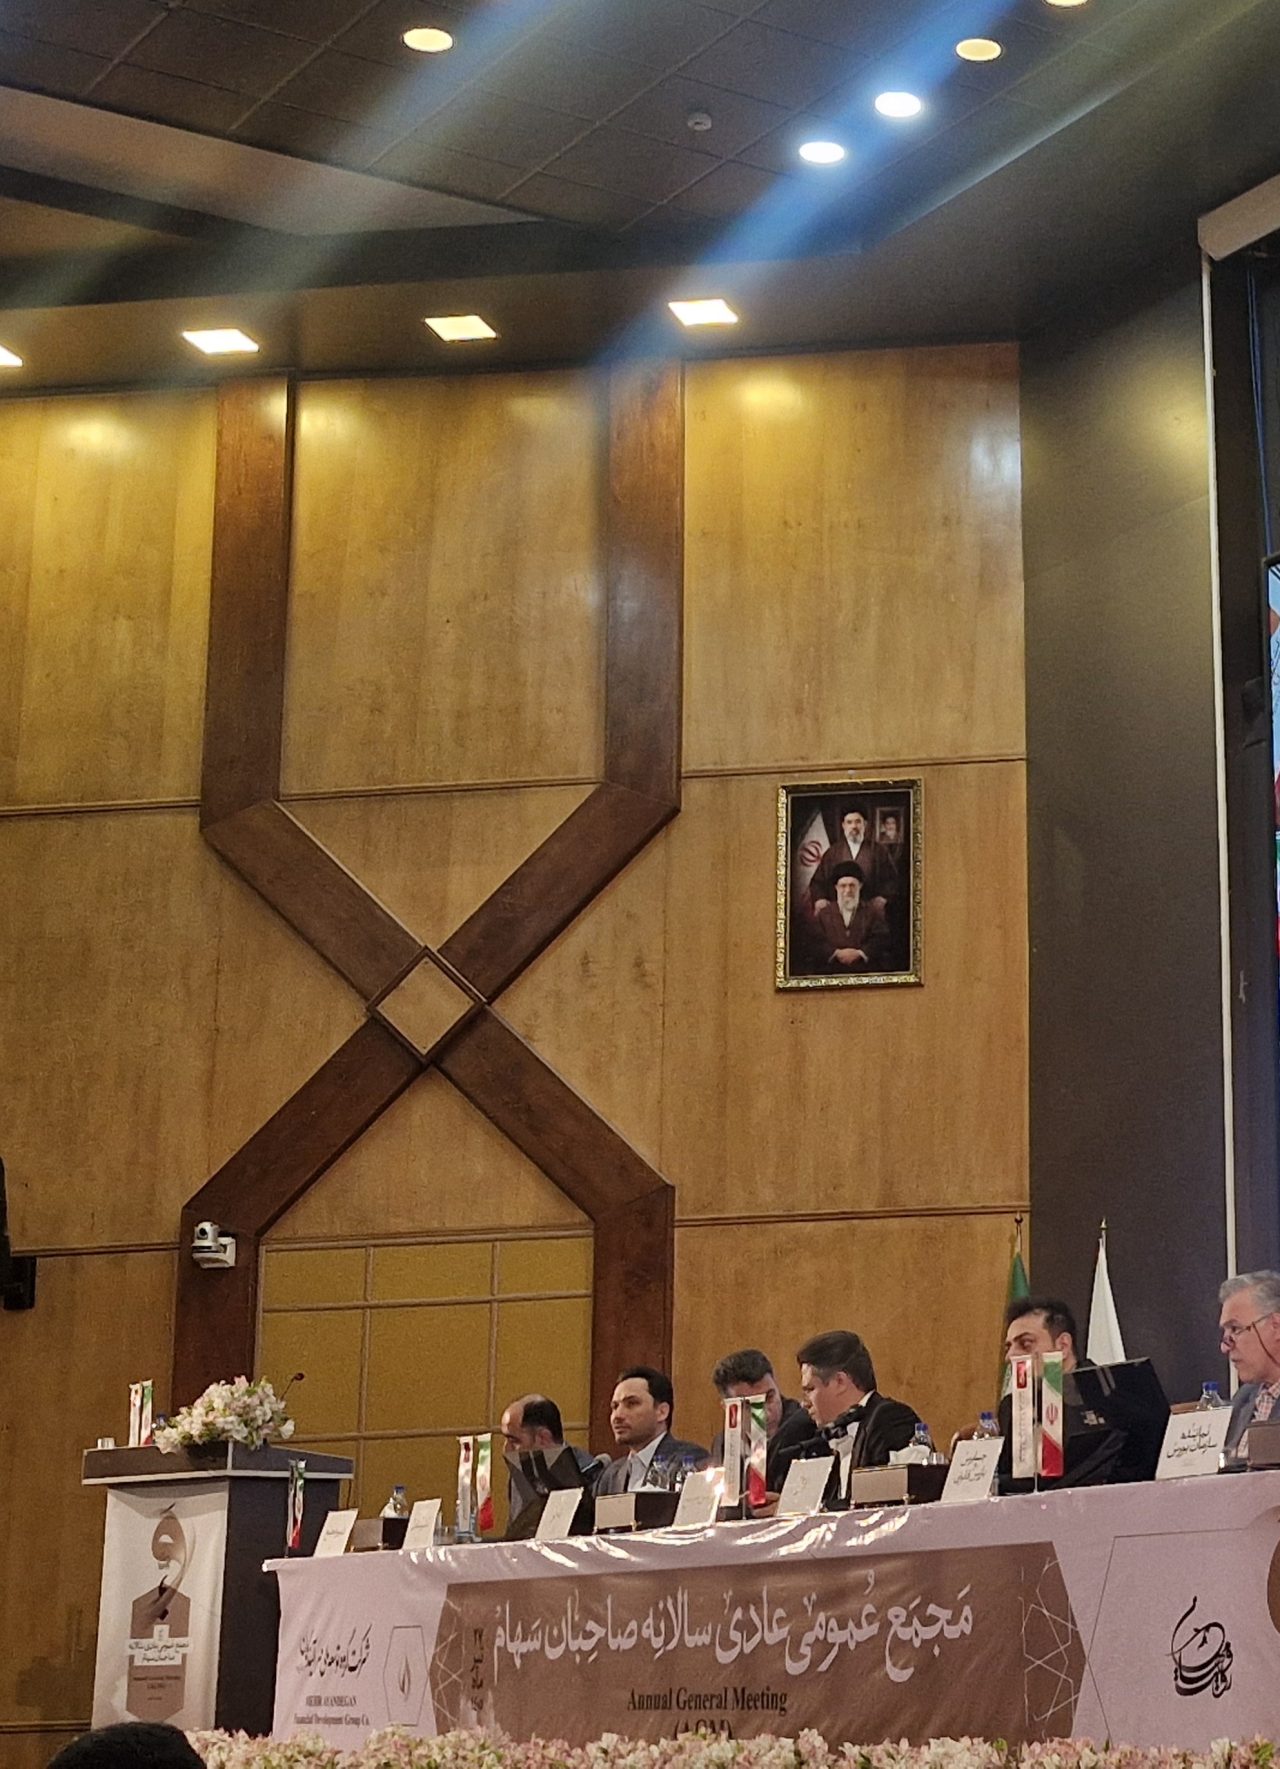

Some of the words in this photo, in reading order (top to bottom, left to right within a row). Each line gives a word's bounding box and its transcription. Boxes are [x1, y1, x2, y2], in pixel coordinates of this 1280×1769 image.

[627, 1686, 674, 1712] Annual
[676, 1686, 729, 1712] General
[731, 1685, 789, 1718] Meeting
